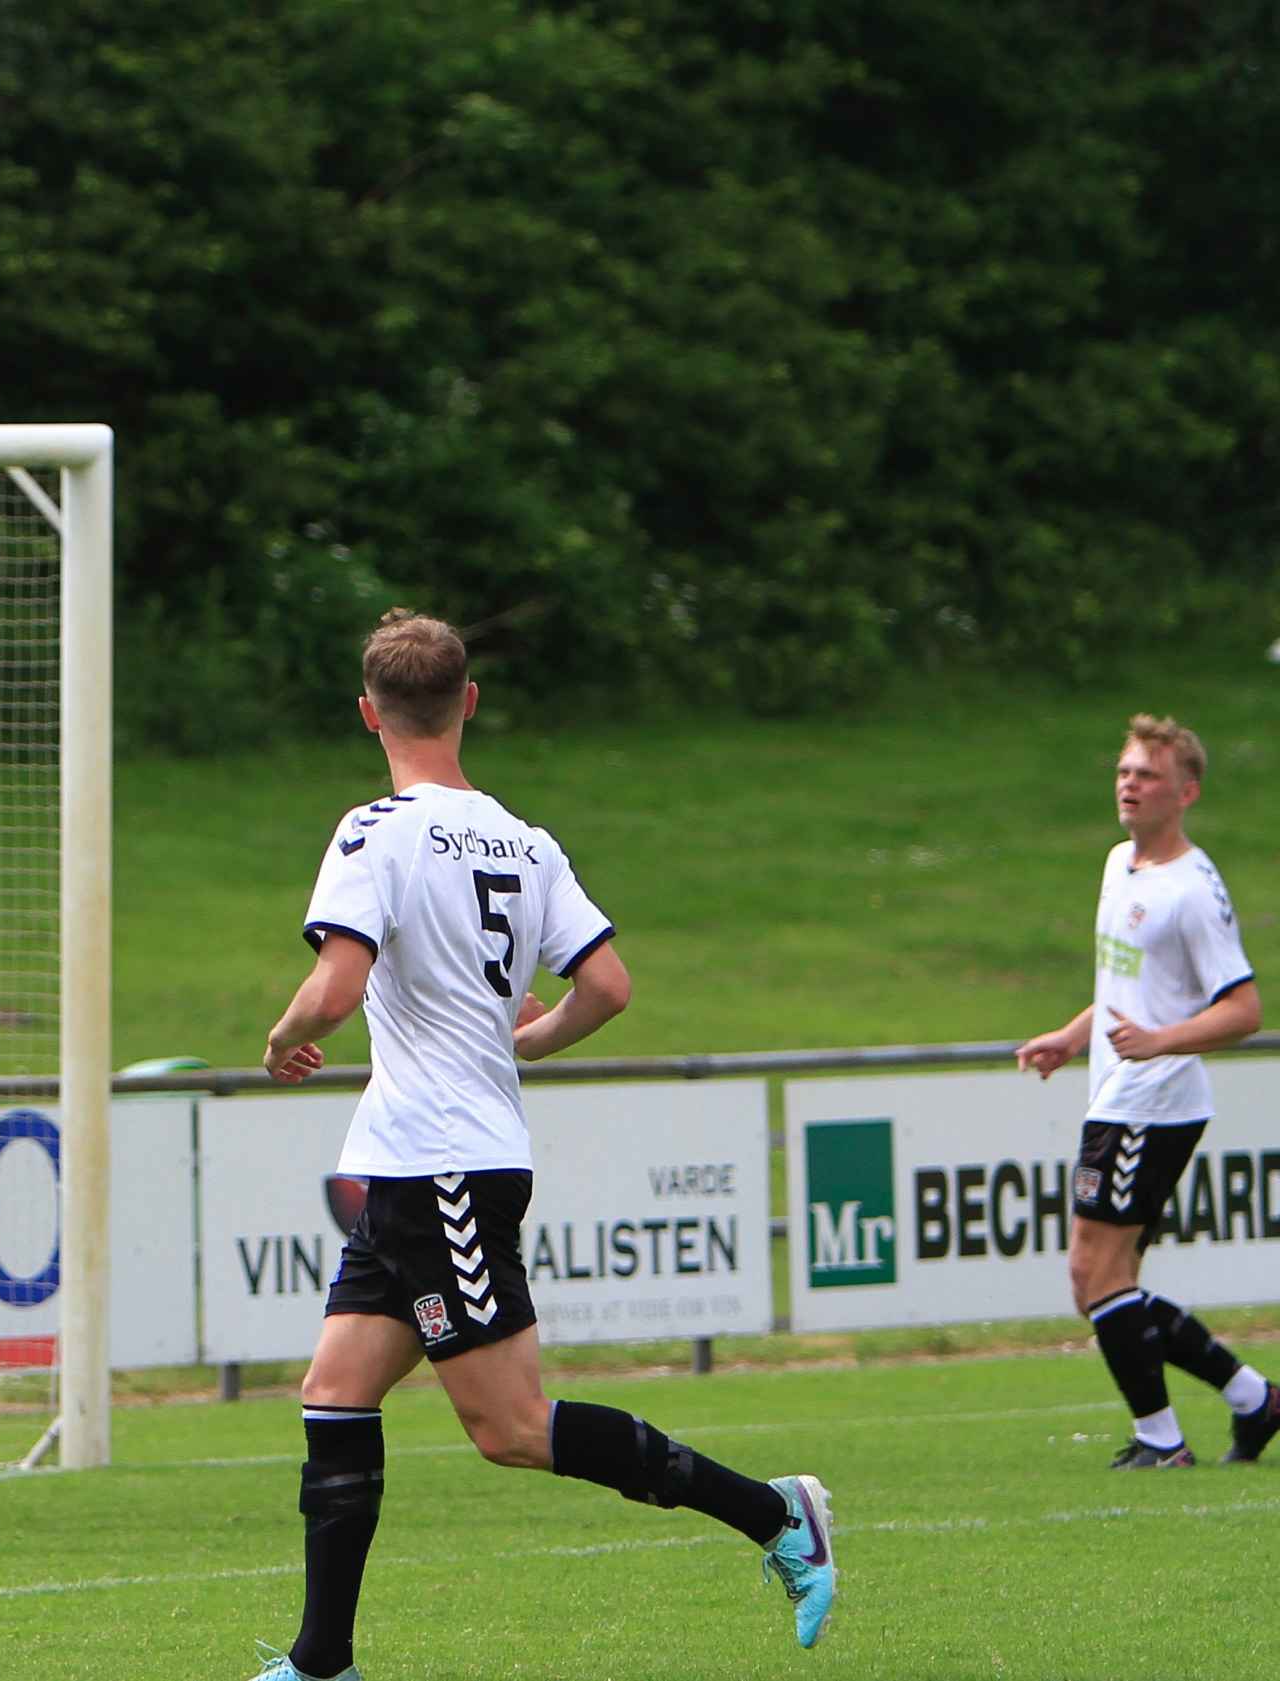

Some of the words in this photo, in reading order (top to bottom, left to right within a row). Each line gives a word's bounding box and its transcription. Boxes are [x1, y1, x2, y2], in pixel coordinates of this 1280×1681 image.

[428, 825, 540, 864] Sydbank
[472, 869, 522, 998] 5
[647, 1163, 737, 1199] VARDE
[527, 1214, 738, 1282] ALISTEN
[808, 1199, 894, 1272] Mr
